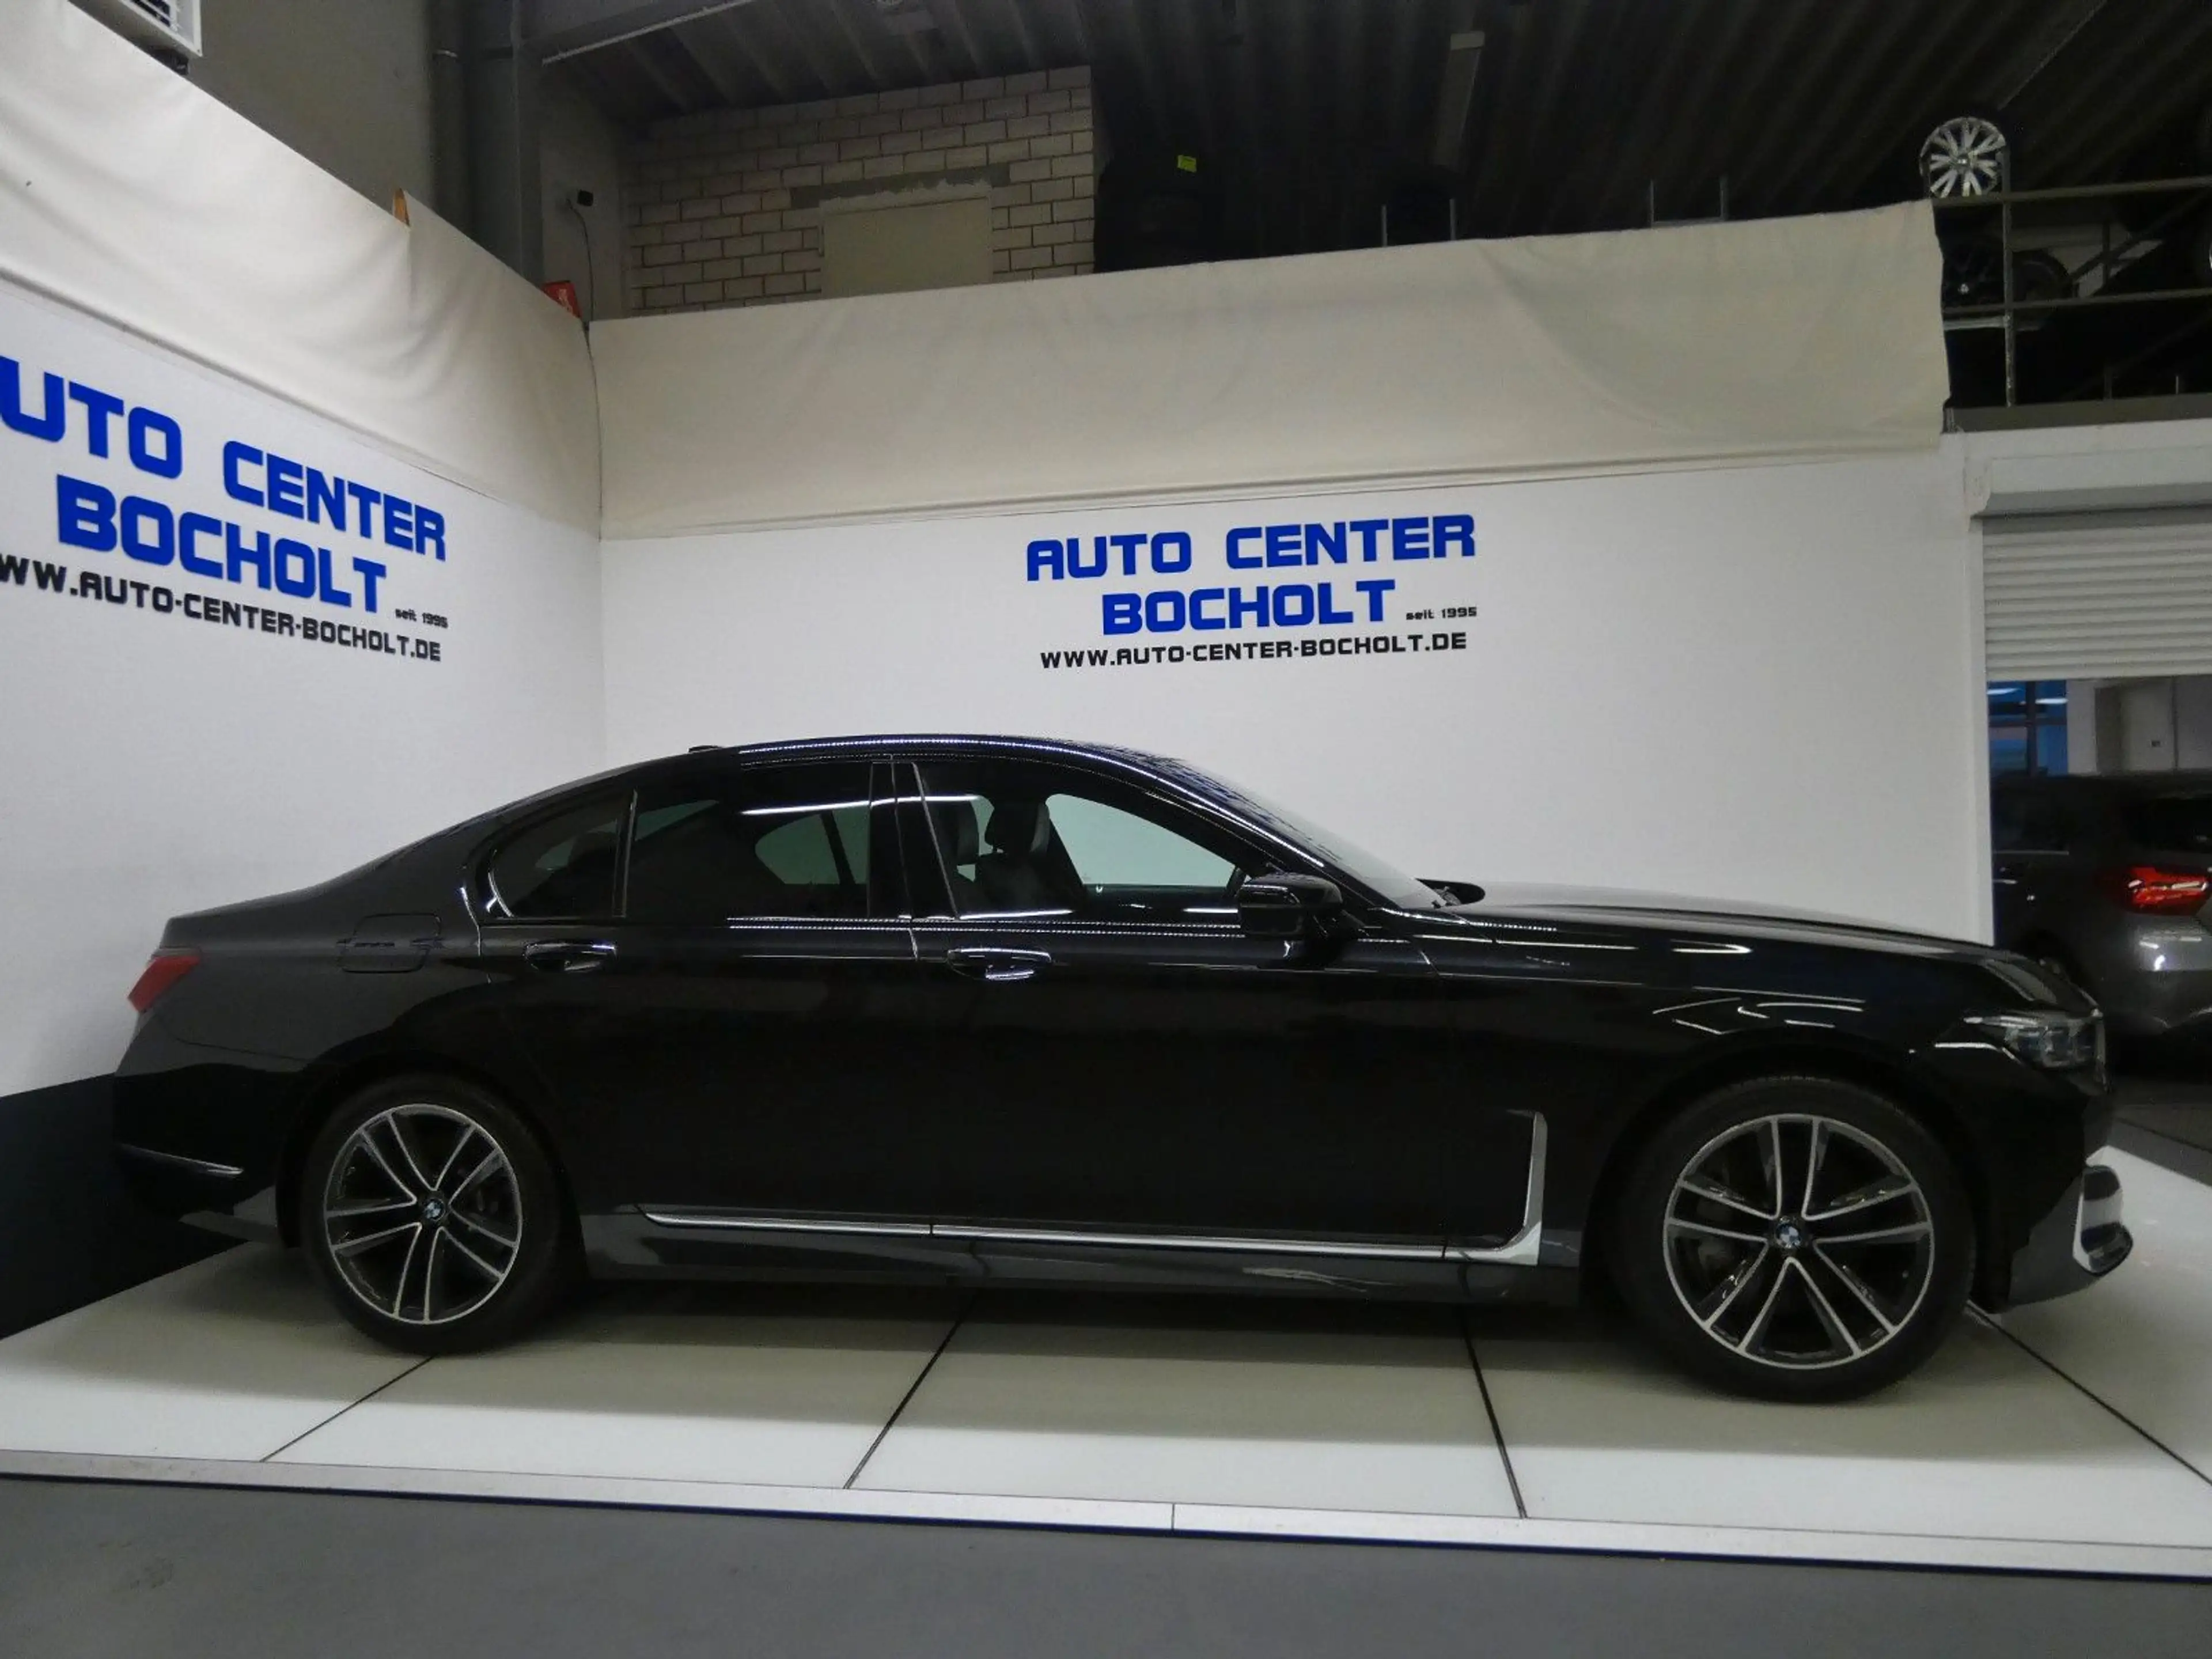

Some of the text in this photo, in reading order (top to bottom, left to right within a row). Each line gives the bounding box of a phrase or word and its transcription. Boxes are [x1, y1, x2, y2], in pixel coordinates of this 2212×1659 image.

[223, 441, 446, 561] CENTER
[56, 474, 386, 612] BOCHOLT
[1027, 514, 1475, 581] AUTO CENTER
[1103, 579, 1477, 635] BOCHOLT seit 1995
[1040, 632, 1467, 669] WWW.AUTO-CENTER-BOCHOLT.DE
